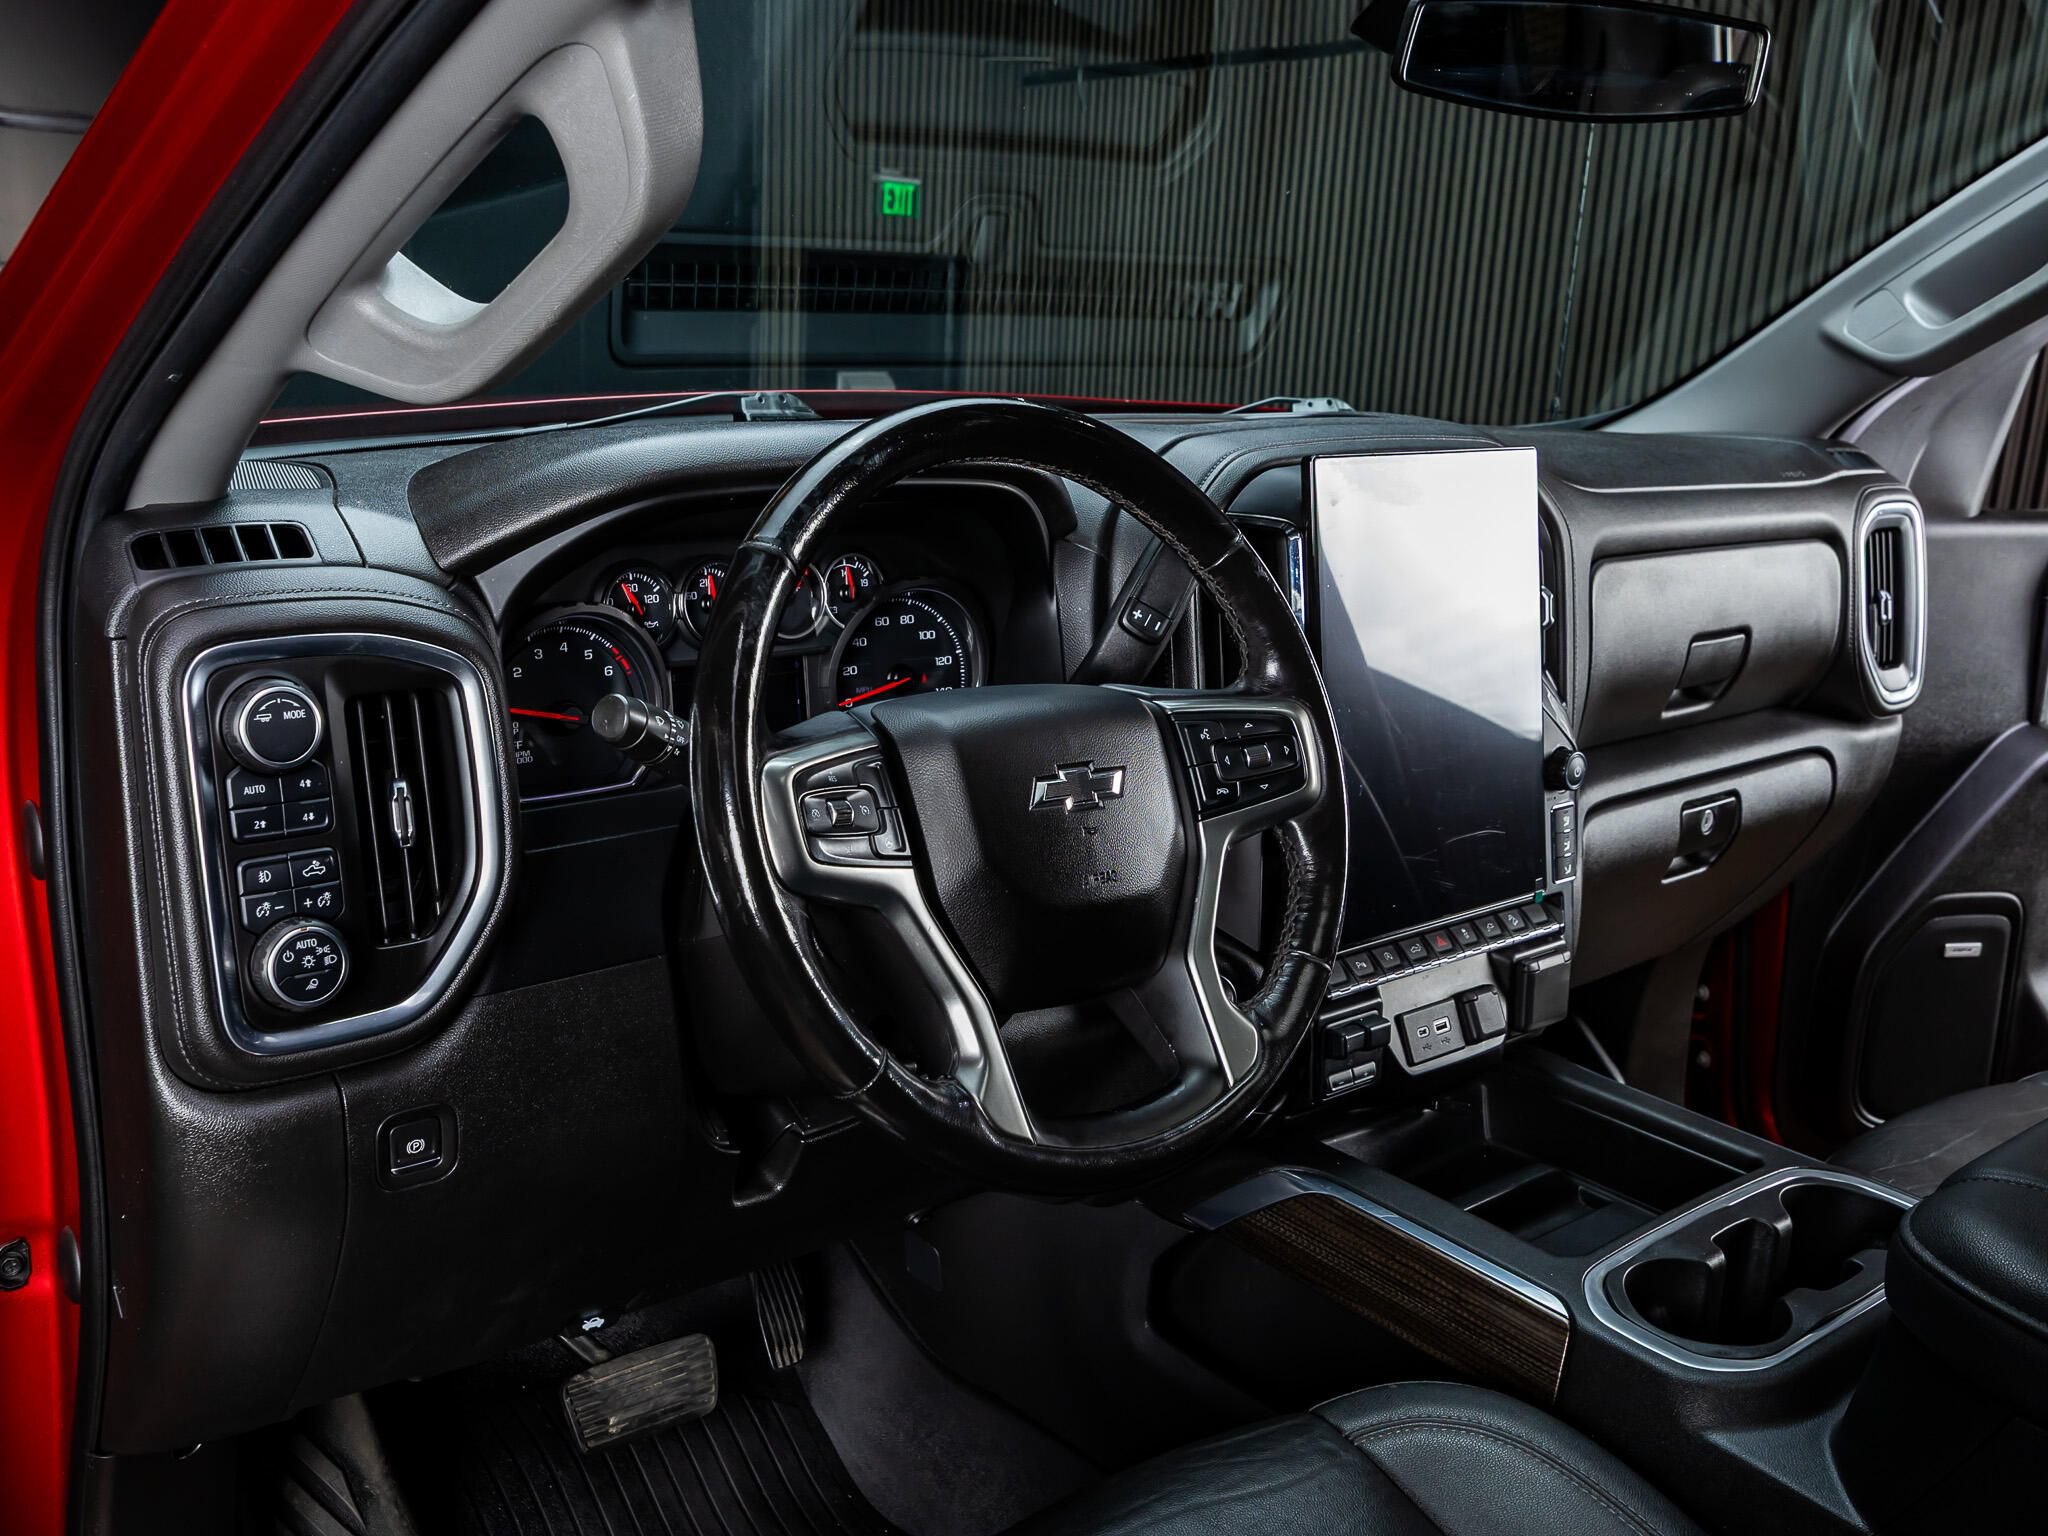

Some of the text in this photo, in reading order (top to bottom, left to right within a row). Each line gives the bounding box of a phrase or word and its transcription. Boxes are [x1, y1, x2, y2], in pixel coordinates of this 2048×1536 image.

[882, 182, 915, 217] EXIT
[644, 594, 660, 604] 120
[875, 616, 890, 627] 60
[900, 614, 915, 625] 80
[918, 630, 936, 640] 100
[560, 642, 568, 653] 4
[852, 637, 867, 647] 40
[534, 648, 543, 660] 3
[584, 649, 593, 660] 5
[935, 655, 952, 666] 120
[512, 667, 522, 678] 2
[604, 665, 614, 677] 6
[843, 665, 858, 676] 20
[283, 709, 307, 721] MODE
[243, 784, 266, 796] AUTO
[295, 938, 318, 950] AUTO
